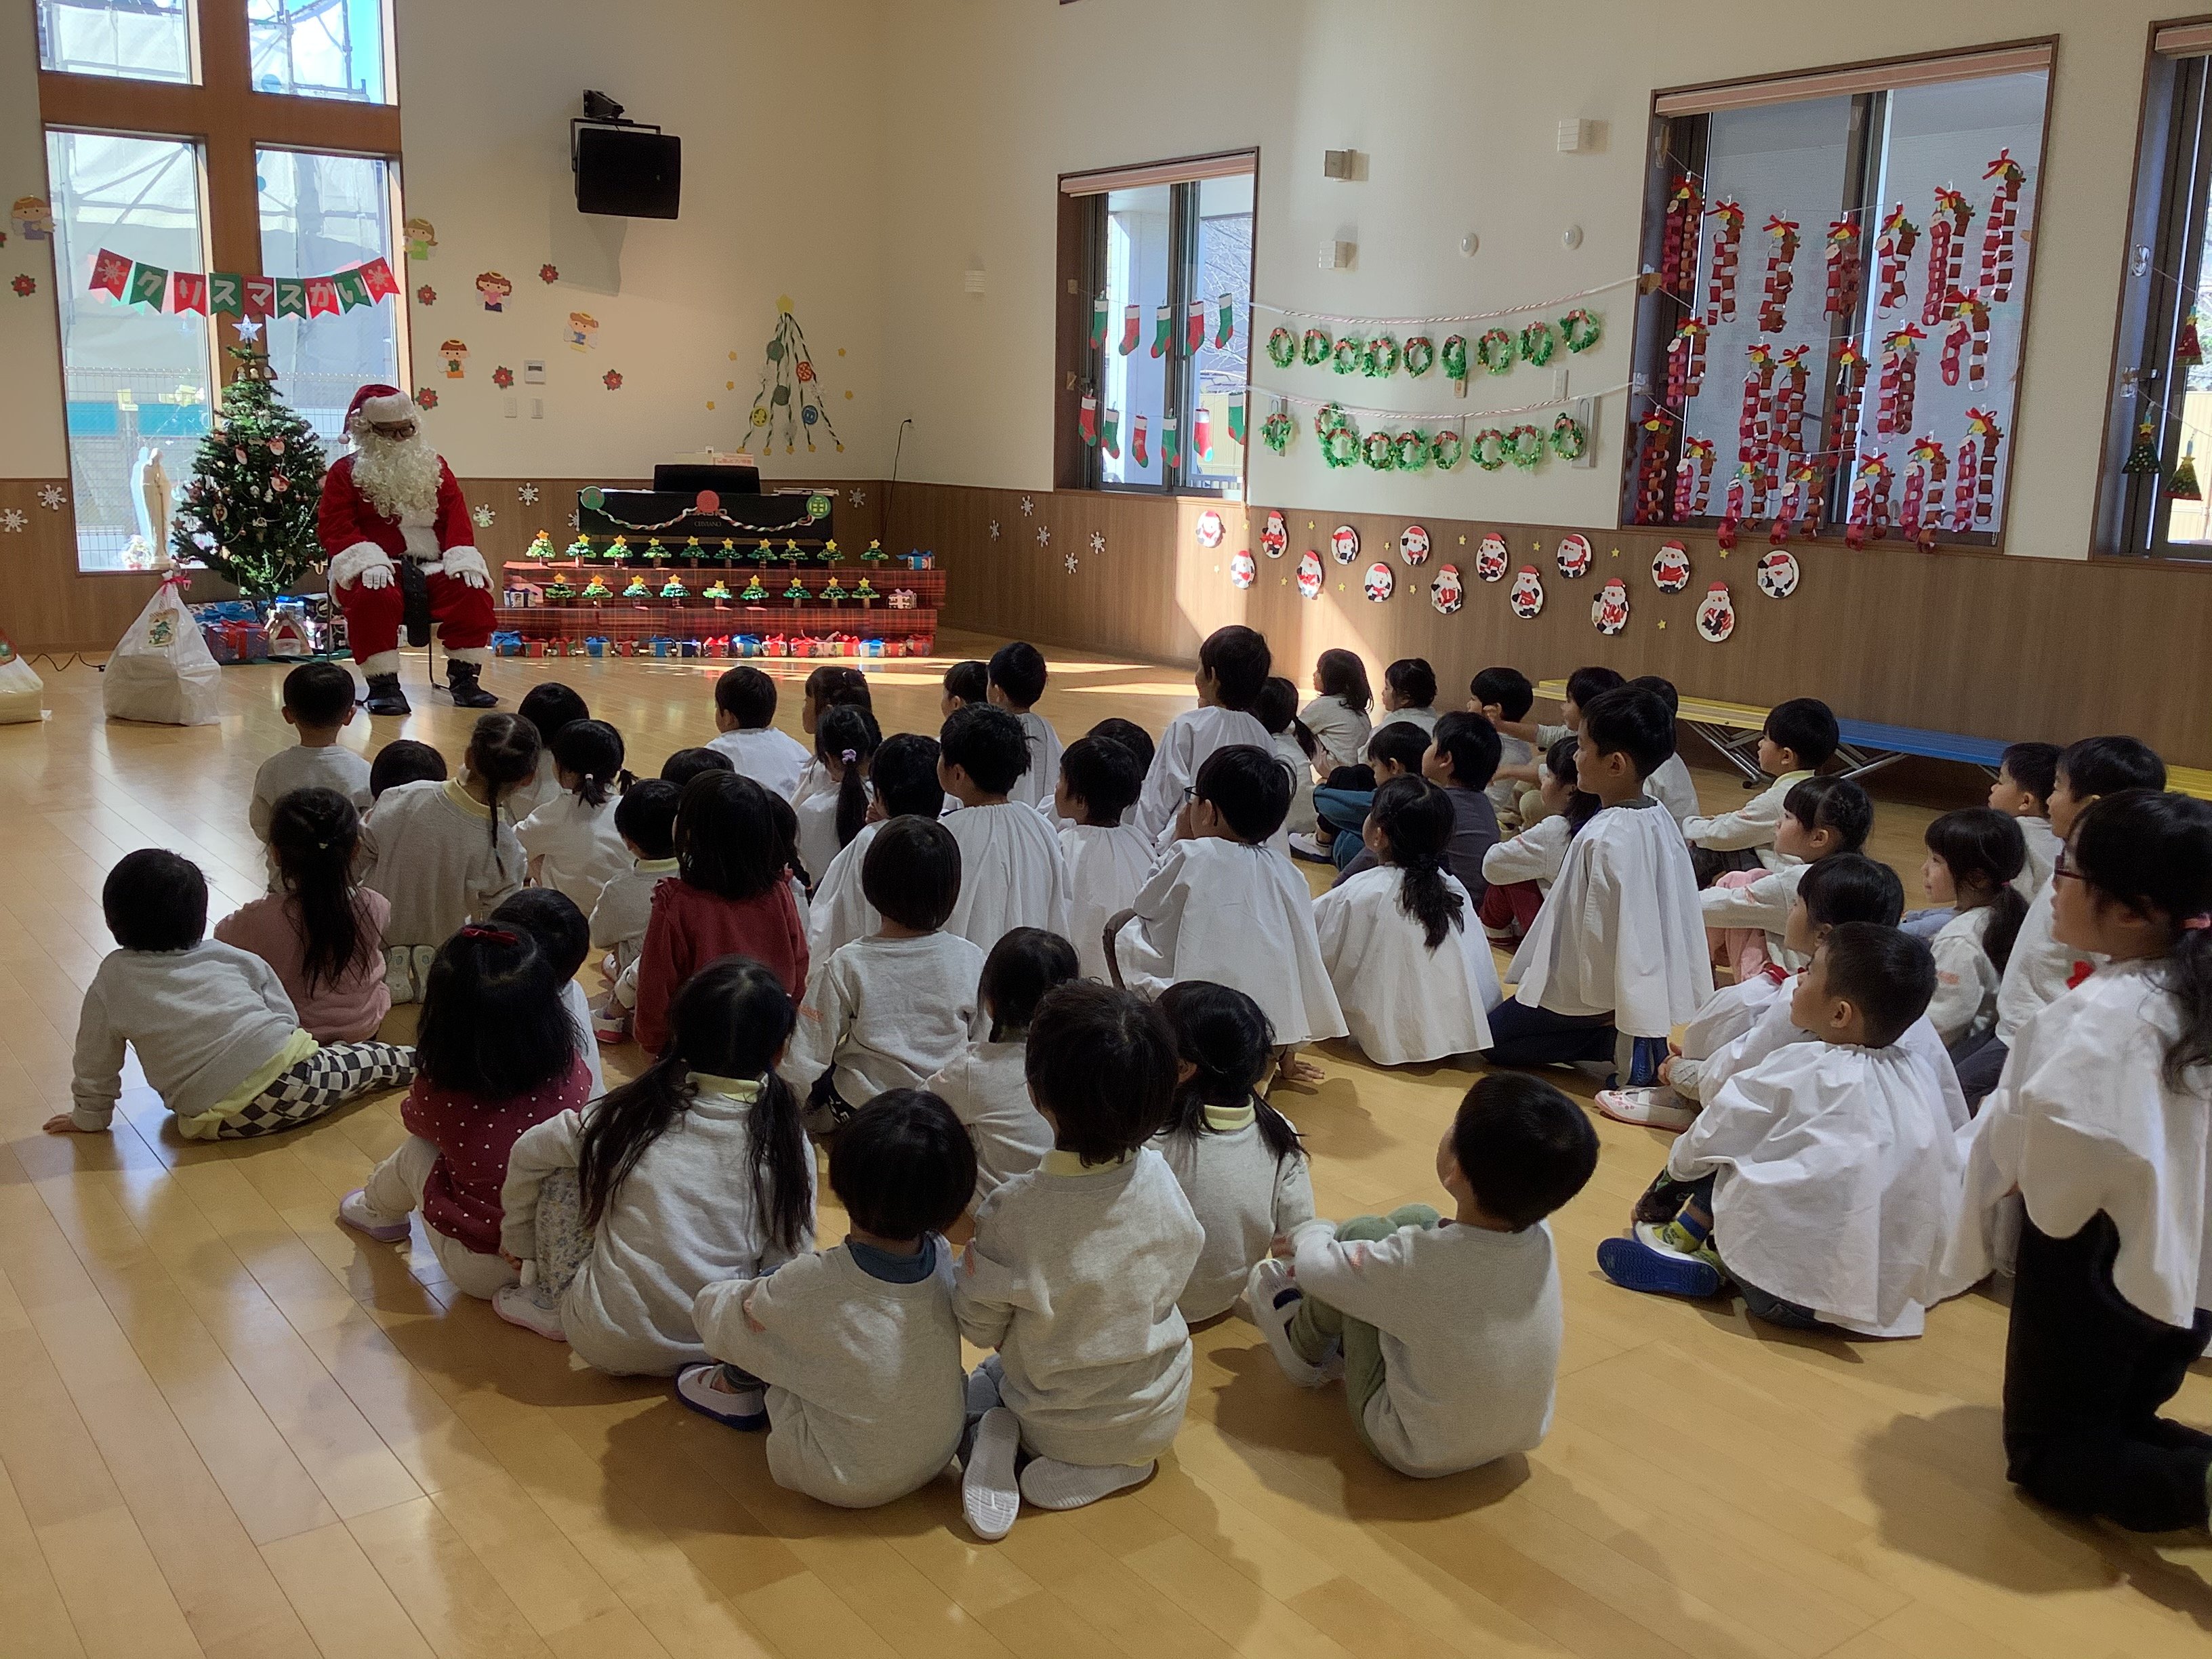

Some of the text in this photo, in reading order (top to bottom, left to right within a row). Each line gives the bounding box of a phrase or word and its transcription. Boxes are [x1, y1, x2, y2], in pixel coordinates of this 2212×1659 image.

[137, 271, 367, 309] クリスマスかい
